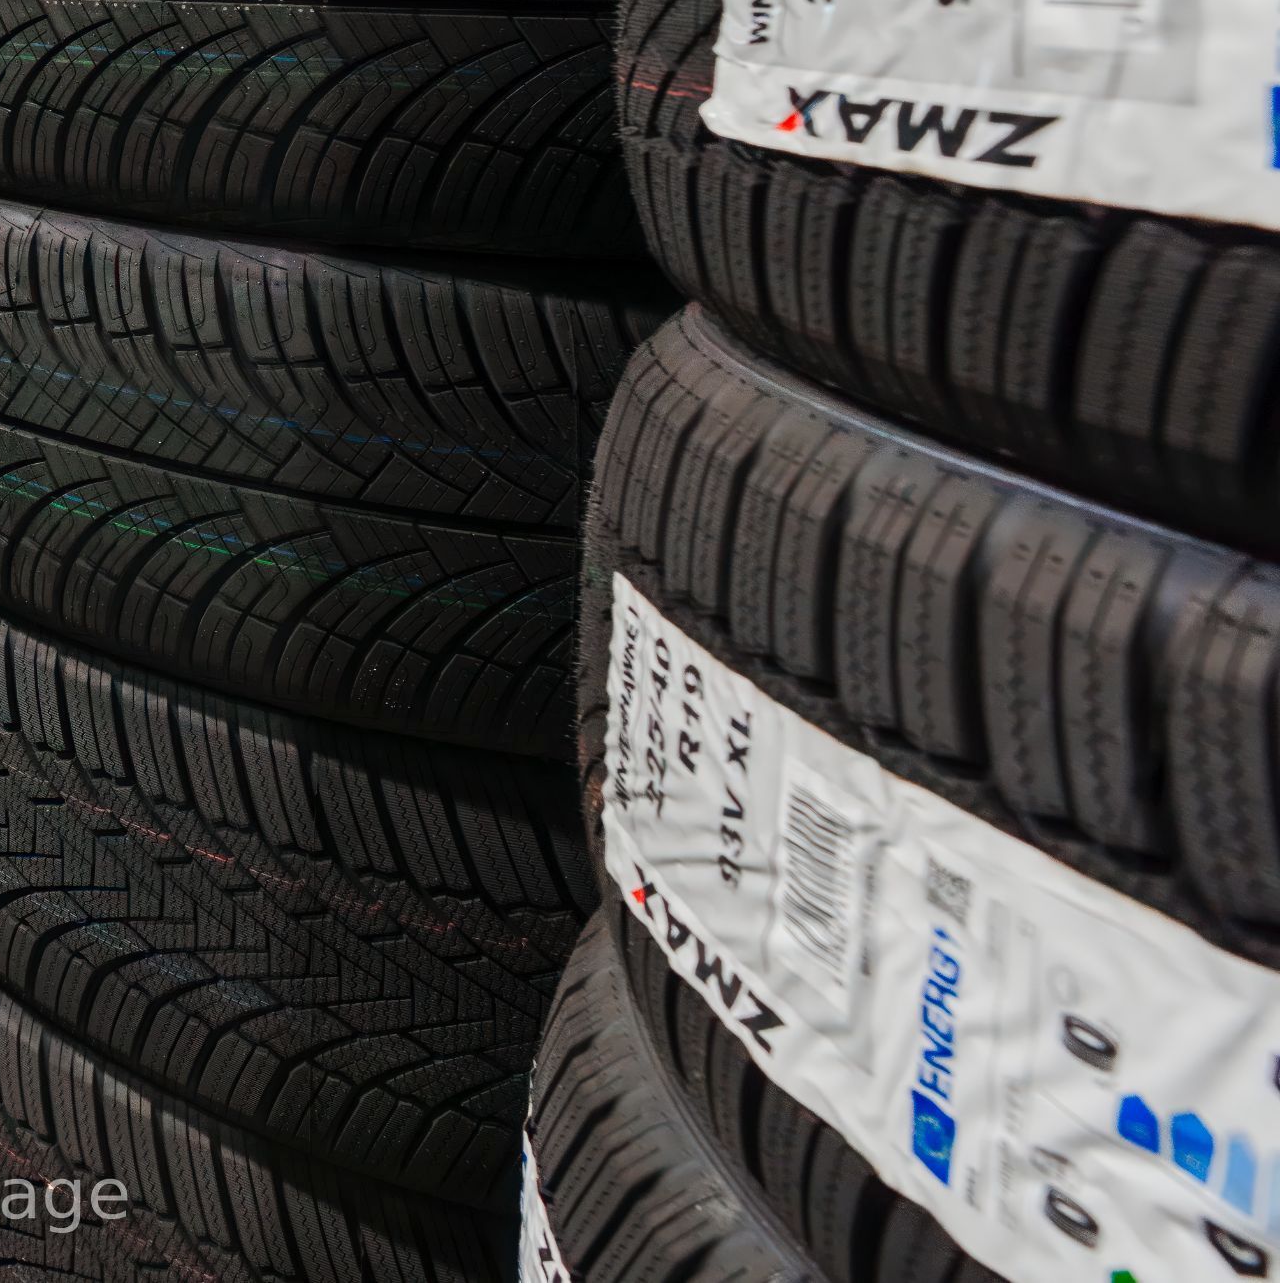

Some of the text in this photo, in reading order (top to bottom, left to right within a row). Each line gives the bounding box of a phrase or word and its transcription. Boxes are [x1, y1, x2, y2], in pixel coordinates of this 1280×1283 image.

[775, 87, 1061, 168] ZMAX
[644, 637, 672, 818] 225/40
[678, 663, 704, 775] R19
[717, 710, 754, 893] 93V XL
[631, 864, 788, 1056] ZMAX
